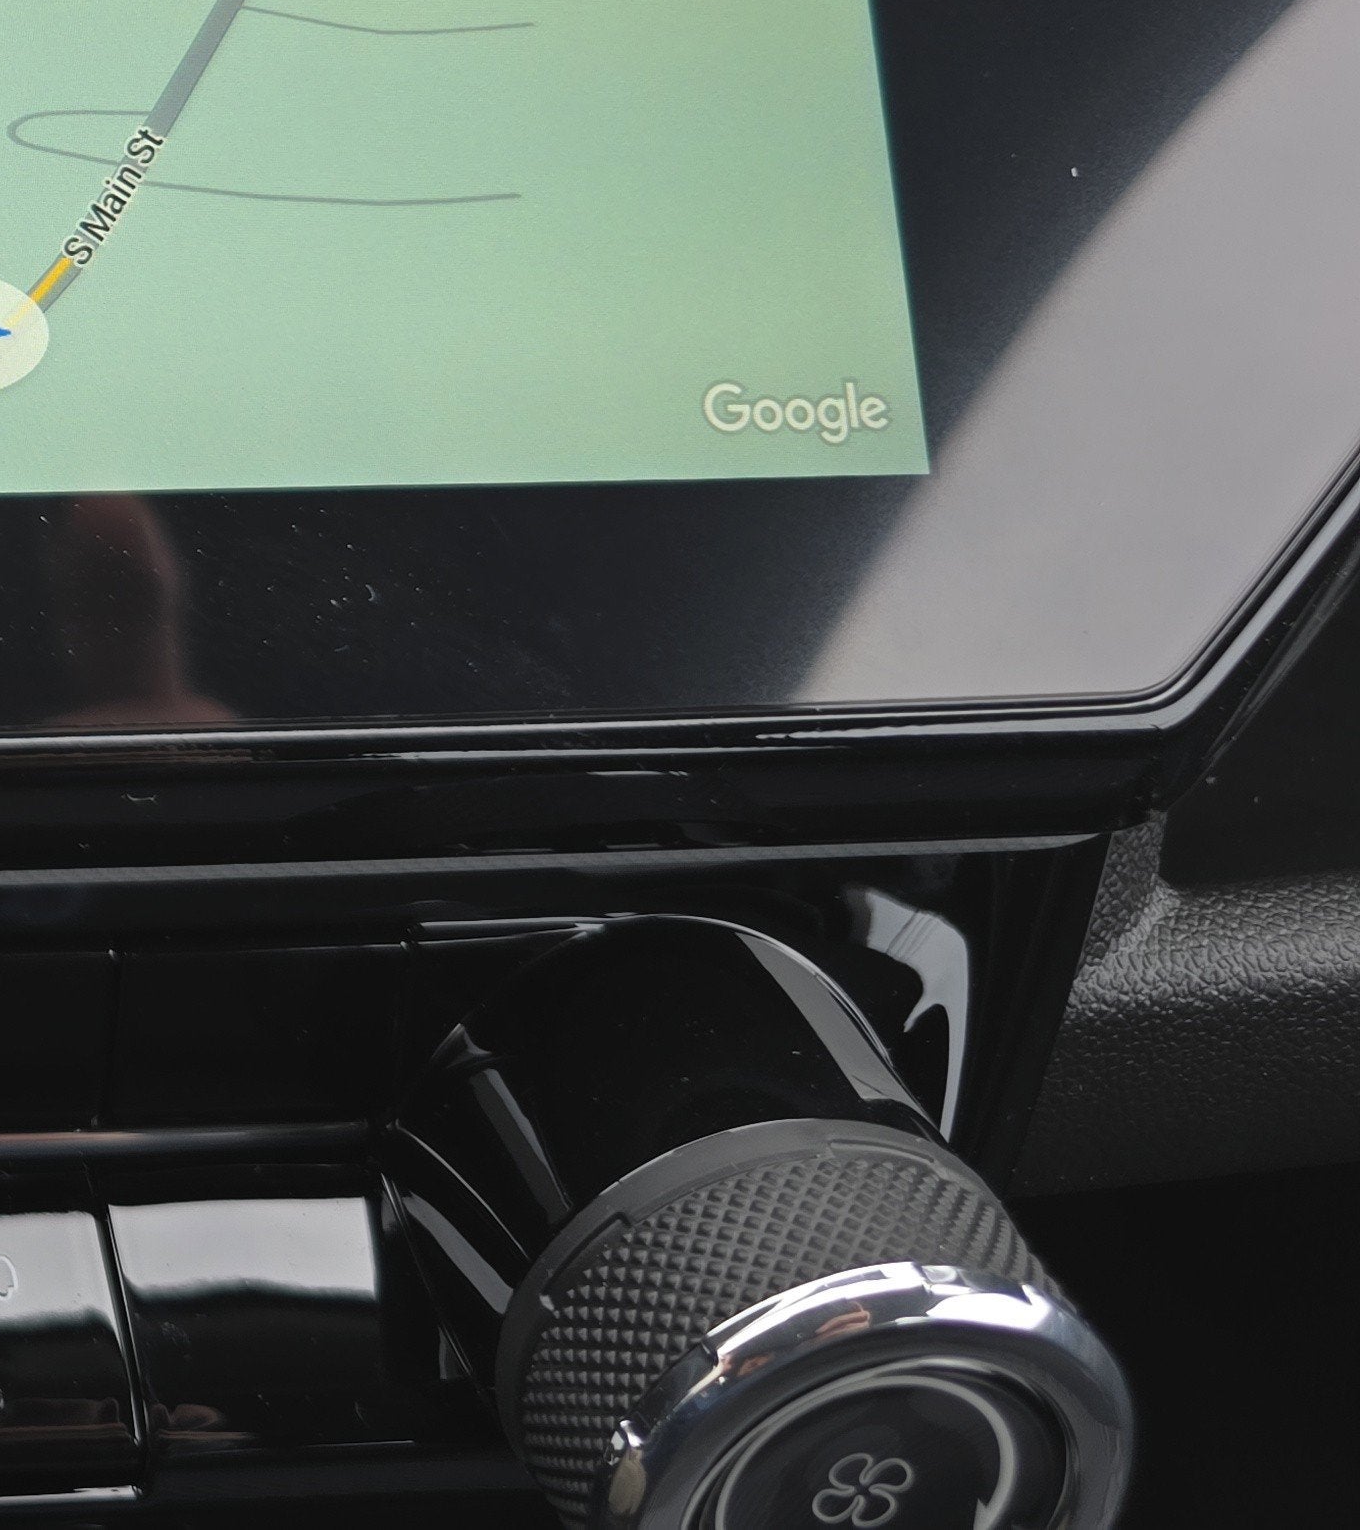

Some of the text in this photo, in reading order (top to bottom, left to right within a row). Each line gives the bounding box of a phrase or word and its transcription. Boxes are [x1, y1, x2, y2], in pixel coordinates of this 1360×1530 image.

[63, 128, 165, 265] S Main St
[703, 381, 889, 444] Google
